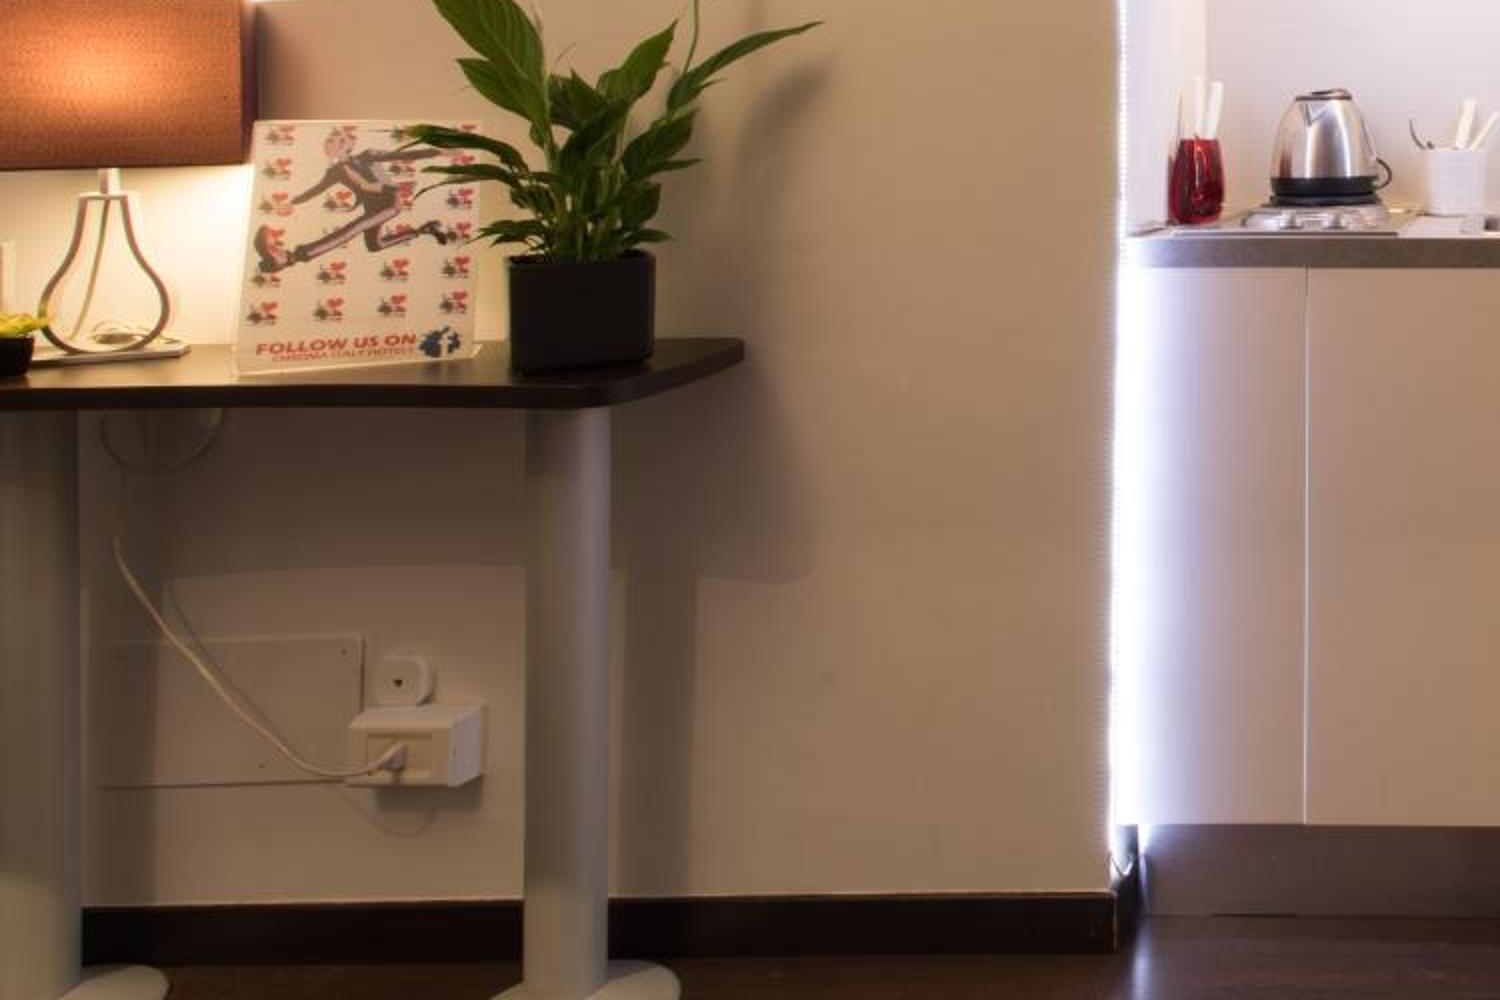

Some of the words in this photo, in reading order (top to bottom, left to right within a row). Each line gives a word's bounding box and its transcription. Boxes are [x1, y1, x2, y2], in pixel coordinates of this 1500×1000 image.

[255, 338, 348, 355] FOLLOW
[353, 335, 379, 348] US
[384, 333, 417, 346] ON
